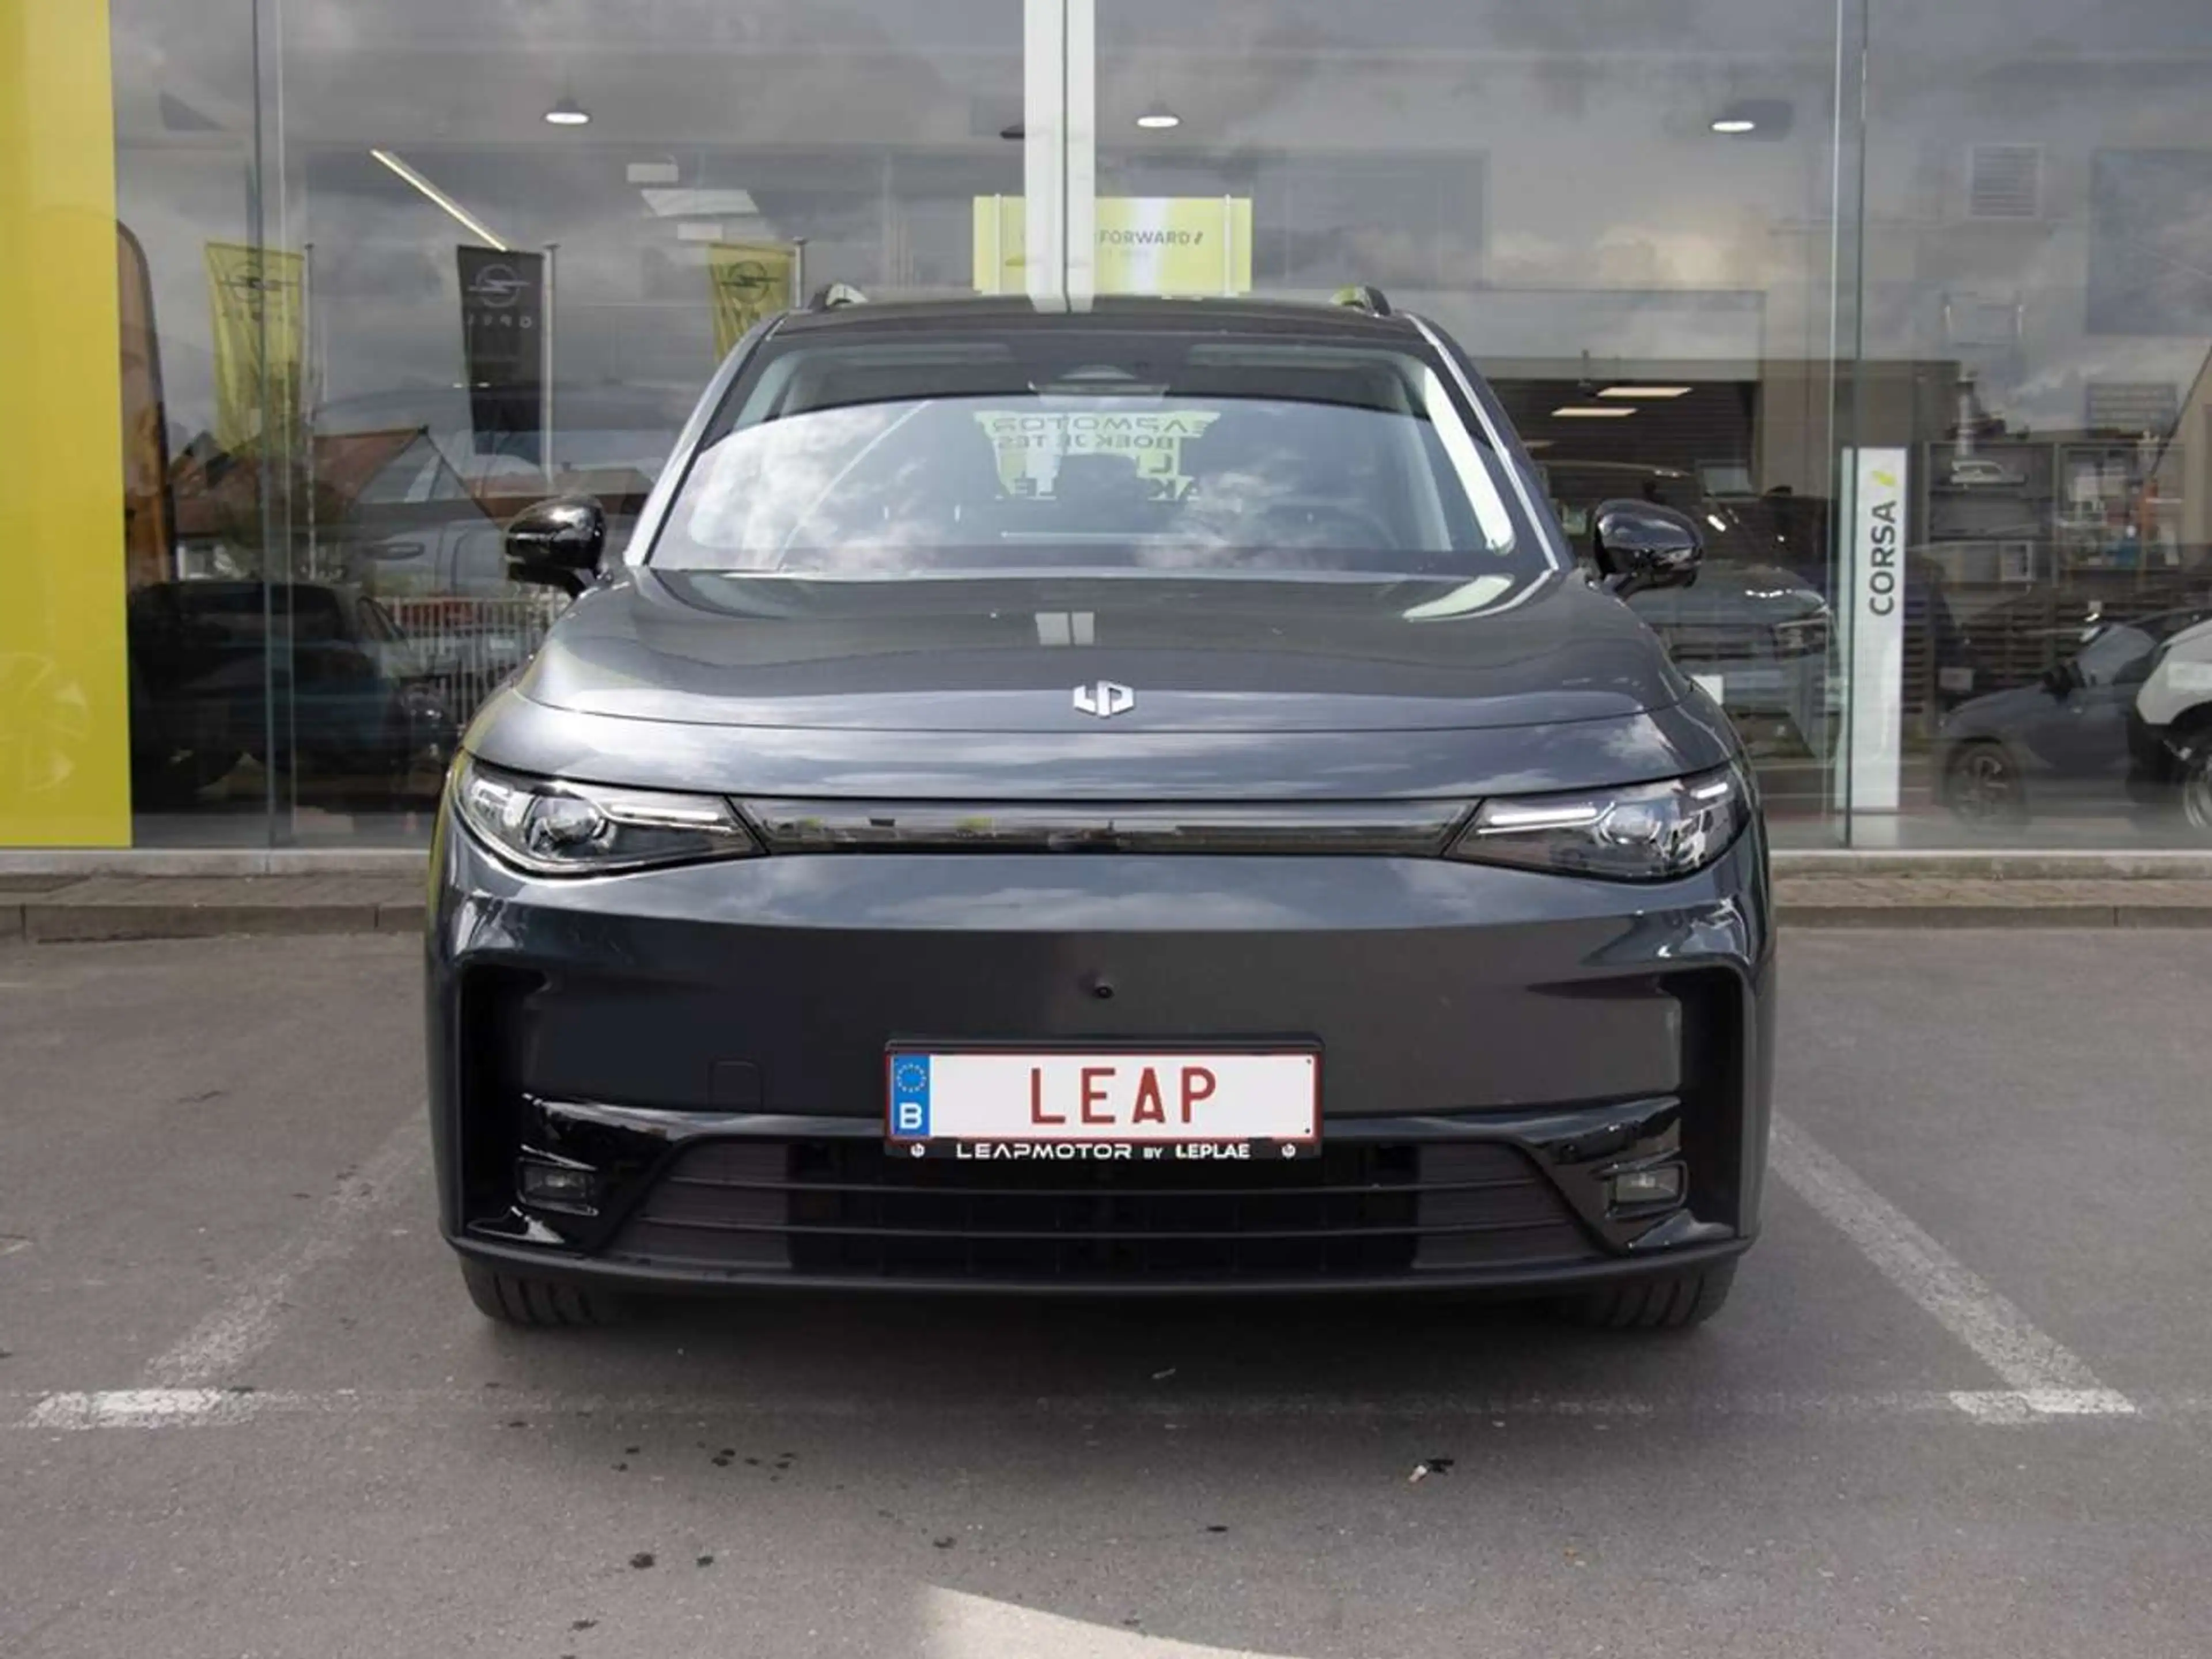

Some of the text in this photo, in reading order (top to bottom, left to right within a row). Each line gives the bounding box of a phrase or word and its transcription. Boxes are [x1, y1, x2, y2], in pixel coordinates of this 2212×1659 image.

[1869, 500, 1897, 616] CORSA
[899, 1102, 922, 1129] B
[1031, 1067, 1217, 1124] LEAP
[956, 1143, 1251, 1160] LEAPMOTOR BY LEPLAE
